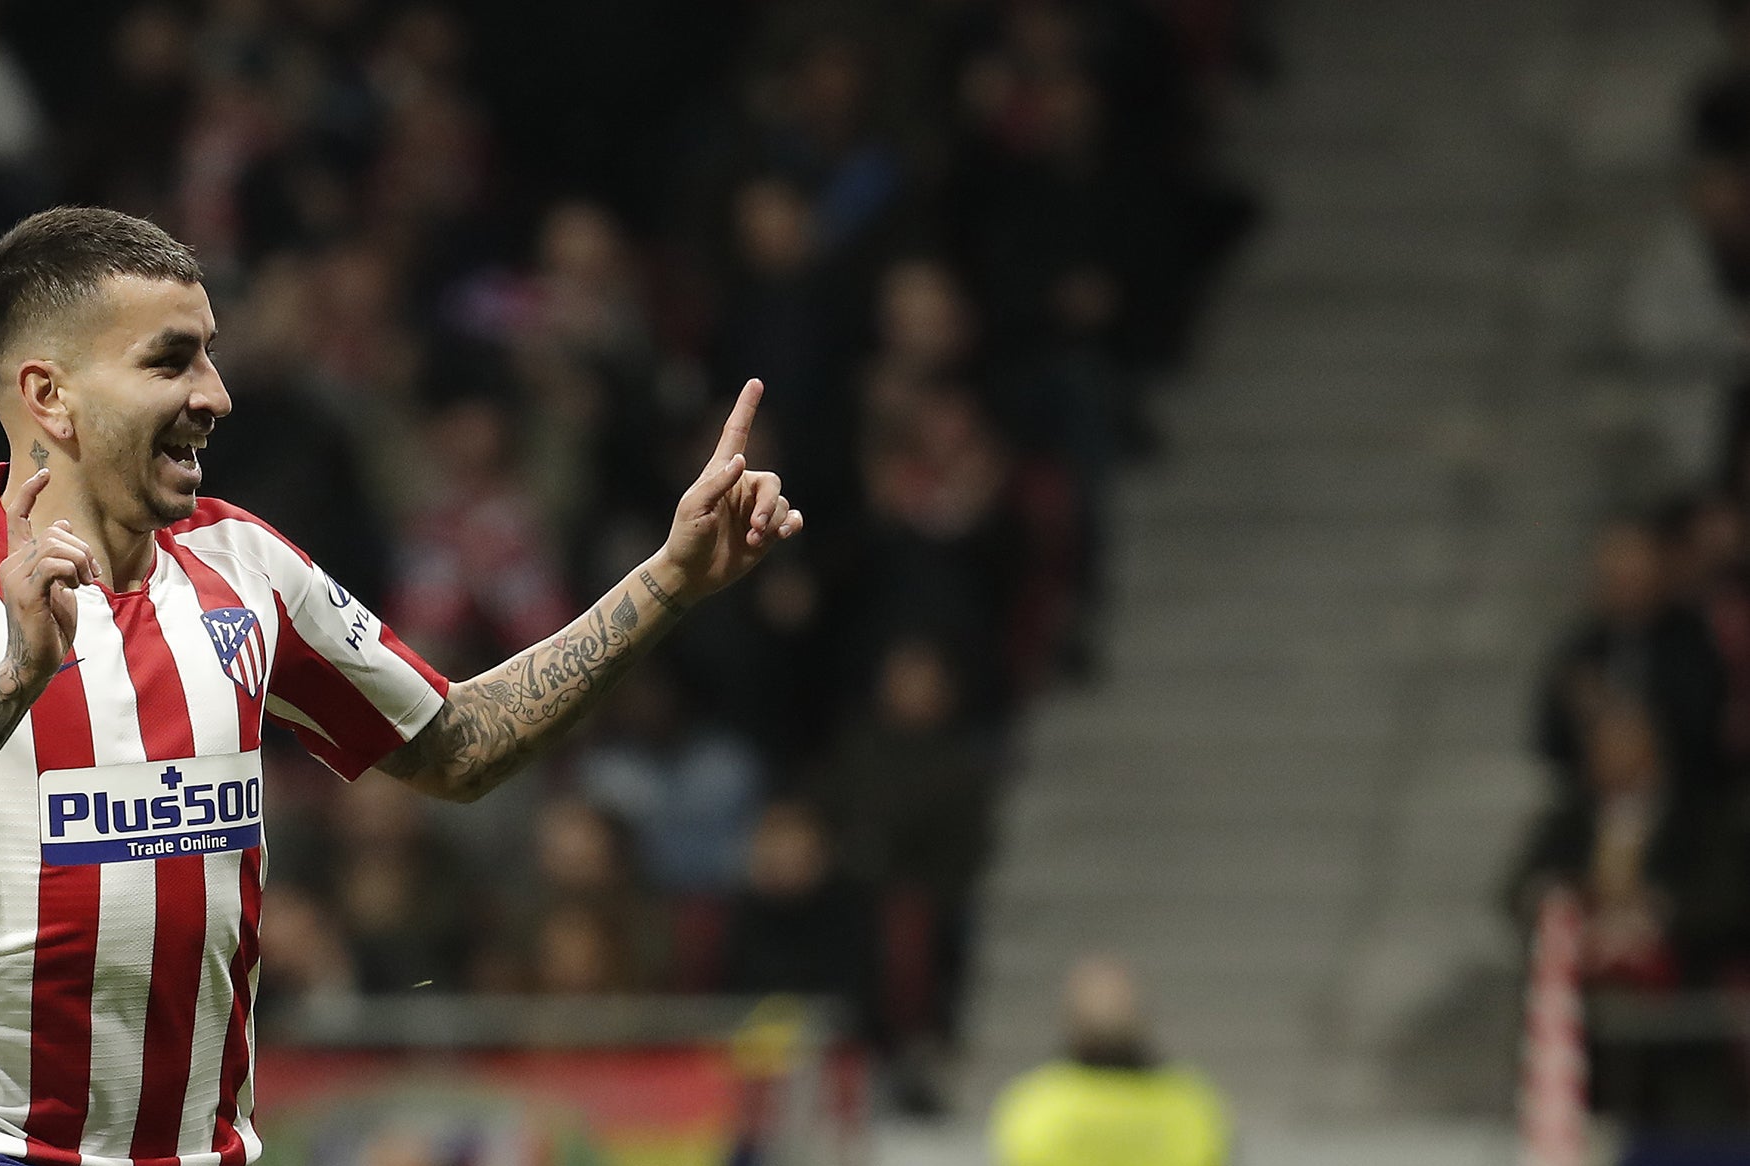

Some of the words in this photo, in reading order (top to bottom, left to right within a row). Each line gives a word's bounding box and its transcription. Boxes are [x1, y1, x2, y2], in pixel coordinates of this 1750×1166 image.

[48, 777, 260, 838] Plus500
[127, 840, 175, 857] Trade
[180, 834, 228, 851] Online
